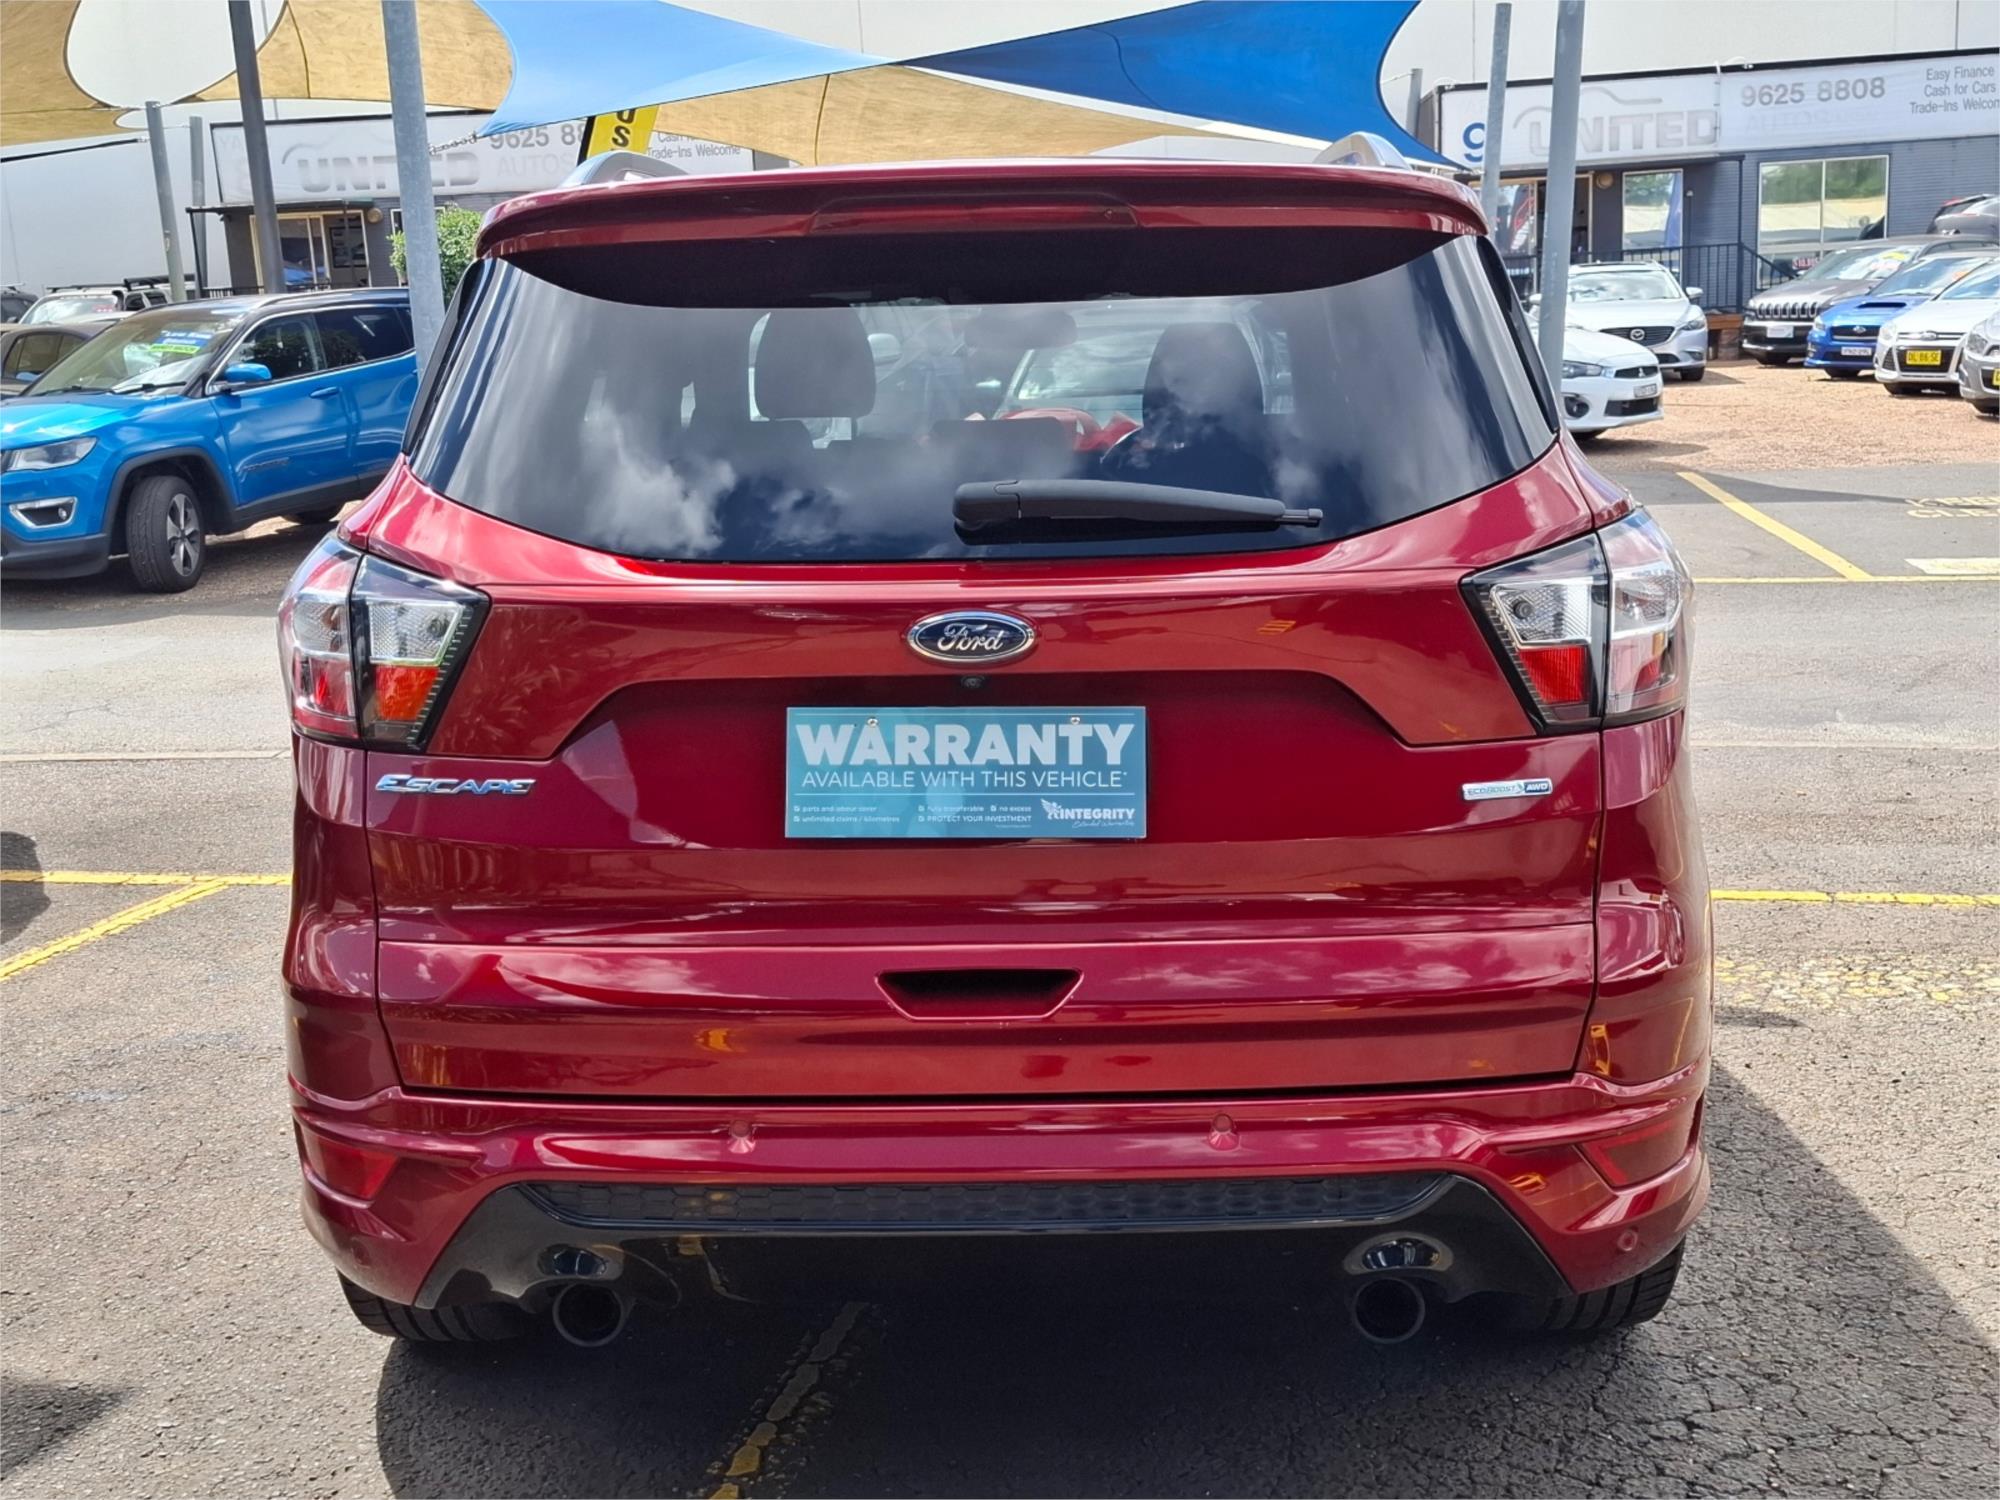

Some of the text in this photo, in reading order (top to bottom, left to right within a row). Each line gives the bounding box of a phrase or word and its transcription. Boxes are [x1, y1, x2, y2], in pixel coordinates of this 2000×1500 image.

[1926, 65, 1995, 83] Easy Finance
[1741, 77, 1886, 107] 9625 8808
[1924, 80, 1997, 98] Cash for Cars
[1909, 99, 1959, 115] Trade-Ins
[490, 126, 550, 150] 9625
[695, 142, 741, 158] Welcome
[297, 151, 480, 193] UNID
[937, 622, 1004, 651] Ford
[795, 723, 1134, 766] WARRANTY
[375, 773, 537, 795] ESCAPE
[802, 770, 915, 788] AVAILABLE
[920, 770, 975, 788] WITH
[980, 770, 1026, 788] THIS
[1526, 783, 1548, 792] AWD
[1060, 808, 1136, 820] INTEGRITY
